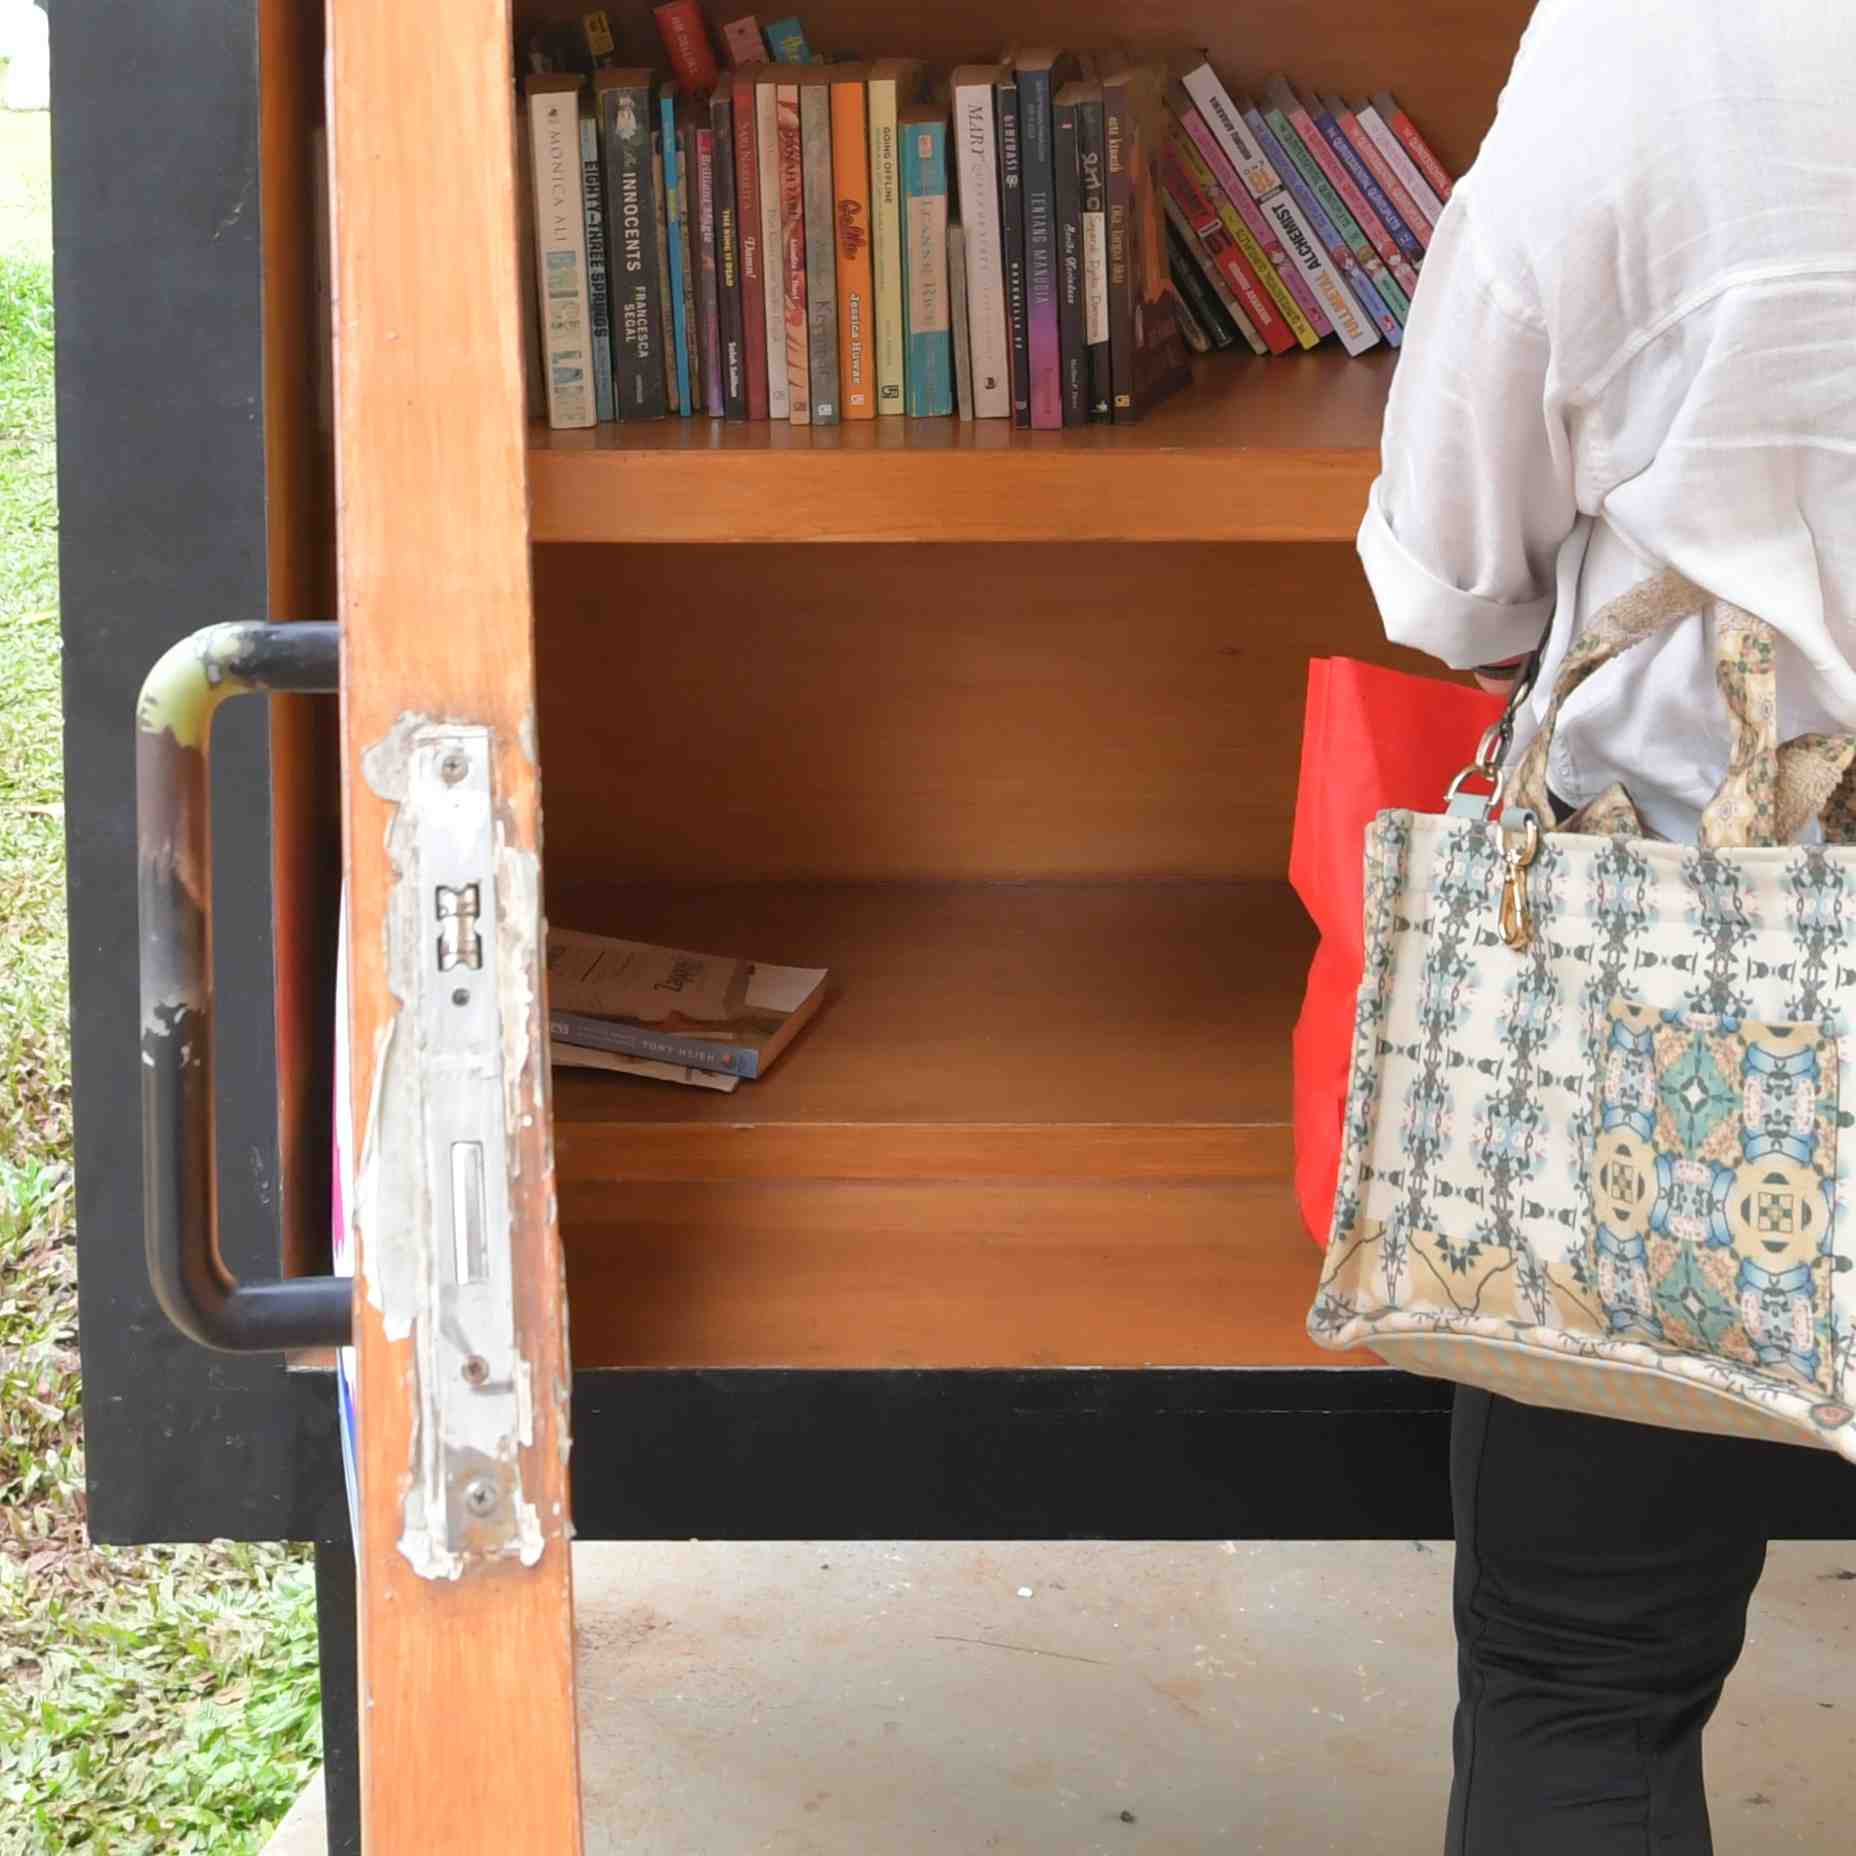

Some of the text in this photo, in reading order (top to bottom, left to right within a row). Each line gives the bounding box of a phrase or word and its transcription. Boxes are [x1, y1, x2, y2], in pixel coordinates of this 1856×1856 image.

[967, 103, 986, 156] MARY
[882, 126, 894, 204] GOING OFFLINE
[622, 172, 642, 272] INNOCENTS
[1030, 191, 1050, 305] TENTANG MANUSIA
[1271, 202, 1322, 272] ALCHEMIST
[623, 304, 637, 343] SEGAL
[634, 286, 649, 359] FRANCESCA
[849, 293, 863, 339] Jessica
[642, 1039, 716, 1064] TONY HSIEH
